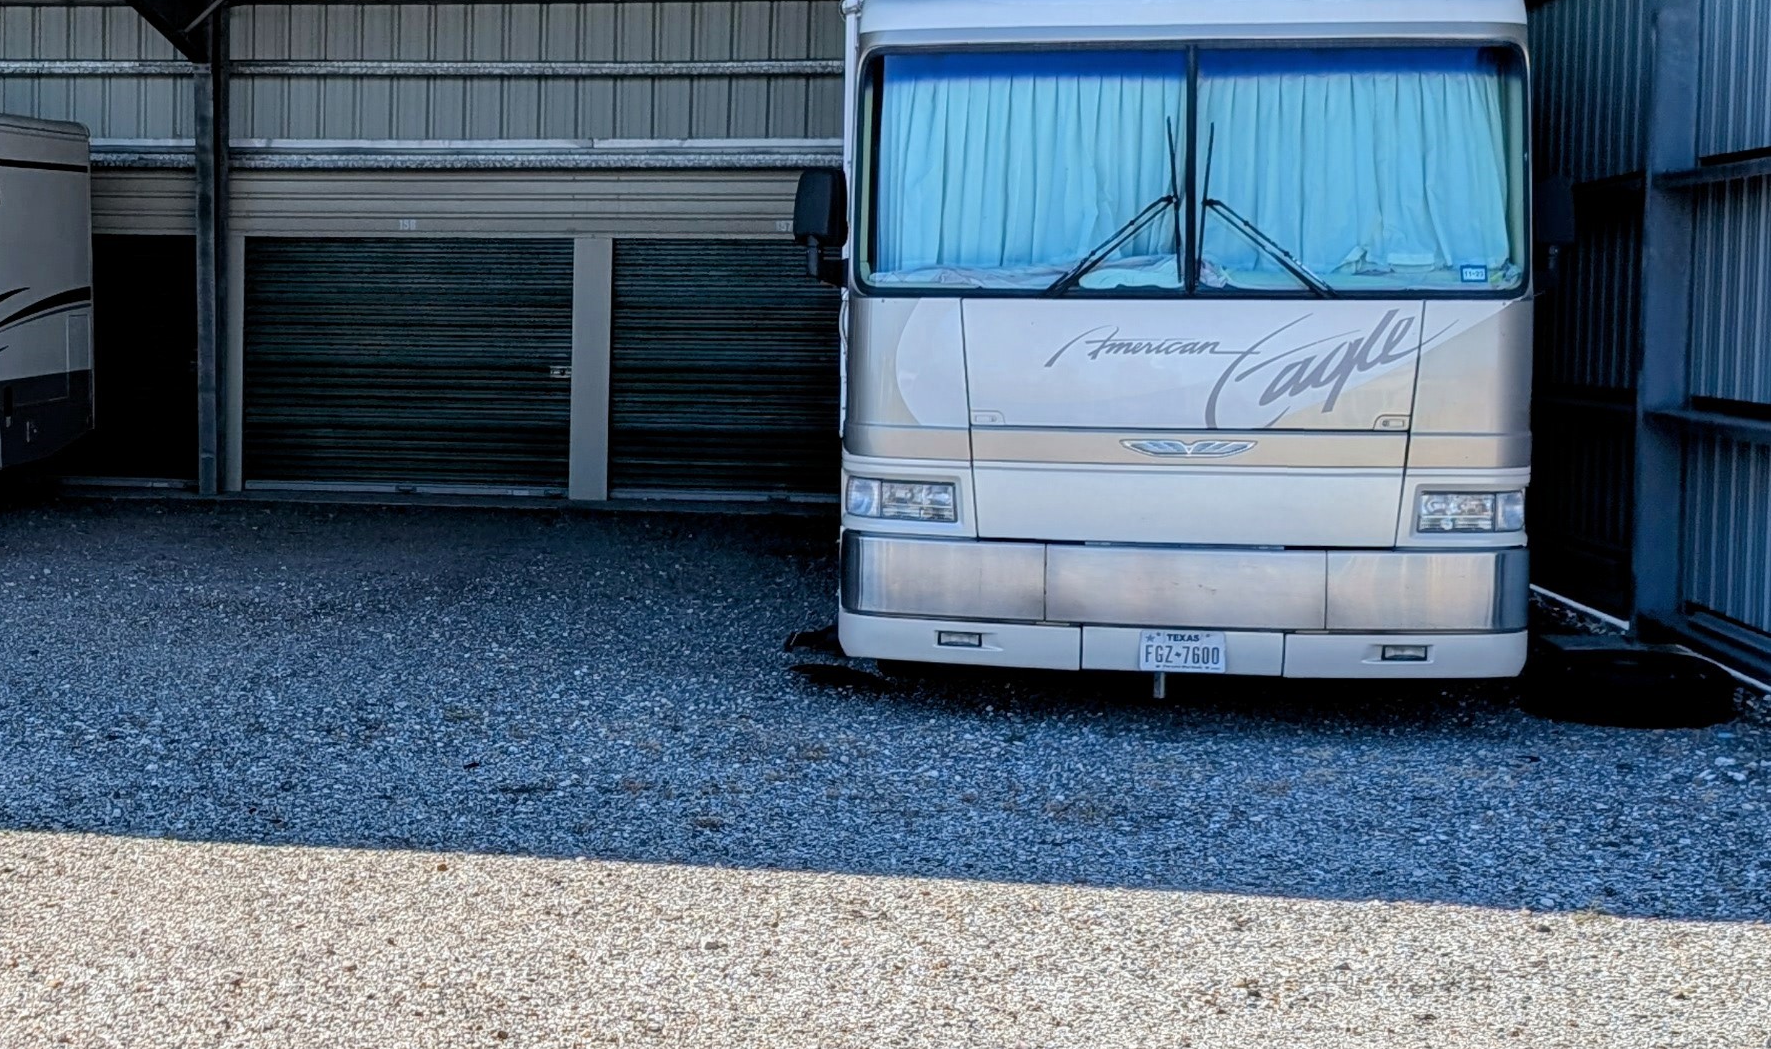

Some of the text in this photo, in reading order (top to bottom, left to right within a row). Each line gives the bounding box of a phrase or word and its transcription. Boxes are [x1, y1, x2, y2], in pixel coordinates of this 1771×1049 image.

[1044, 308, 1460, 429] American Eagle
[1166, 633, 1200, 642] TEXAS
